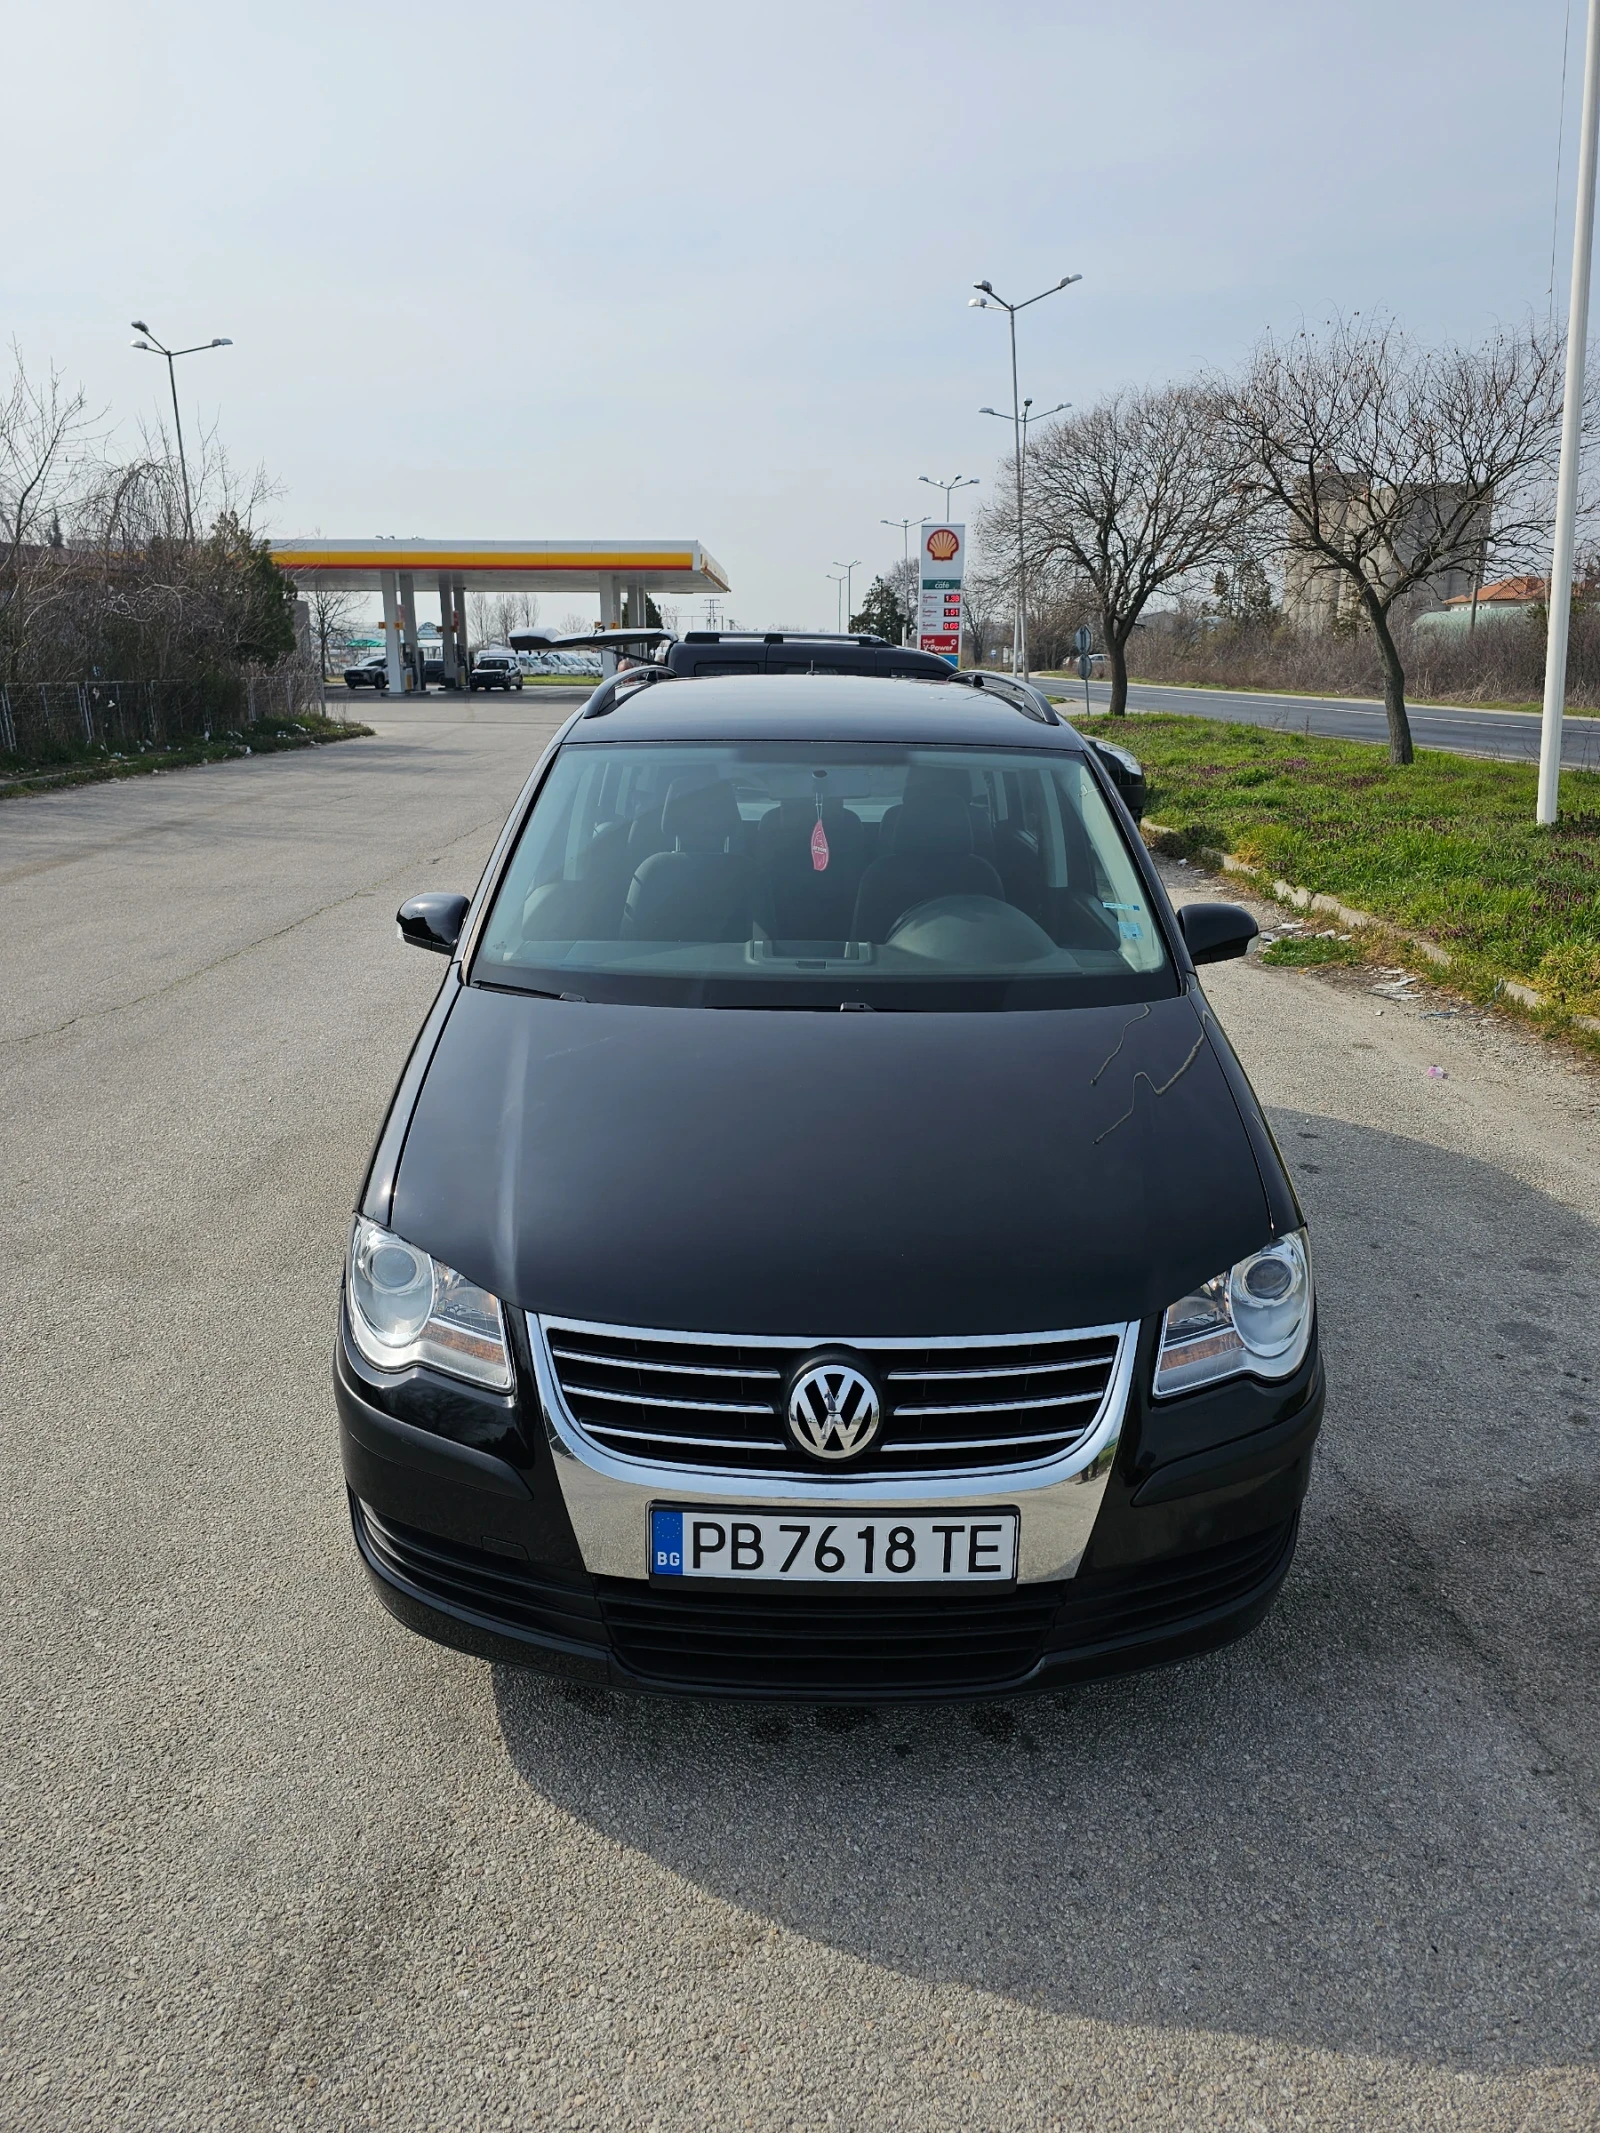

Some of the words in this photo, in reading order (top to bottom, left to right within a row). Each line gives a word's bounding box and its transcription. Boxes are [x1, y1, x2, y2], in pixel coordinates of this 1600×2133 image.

[934, 581, 950, 589] café
[692, 1521, 764, 1571] PB
[778, 1525, 916, 1574] 7618
[932, 1524, 1003, 1574] TE
[657, 1551, 680, 1566] BG
